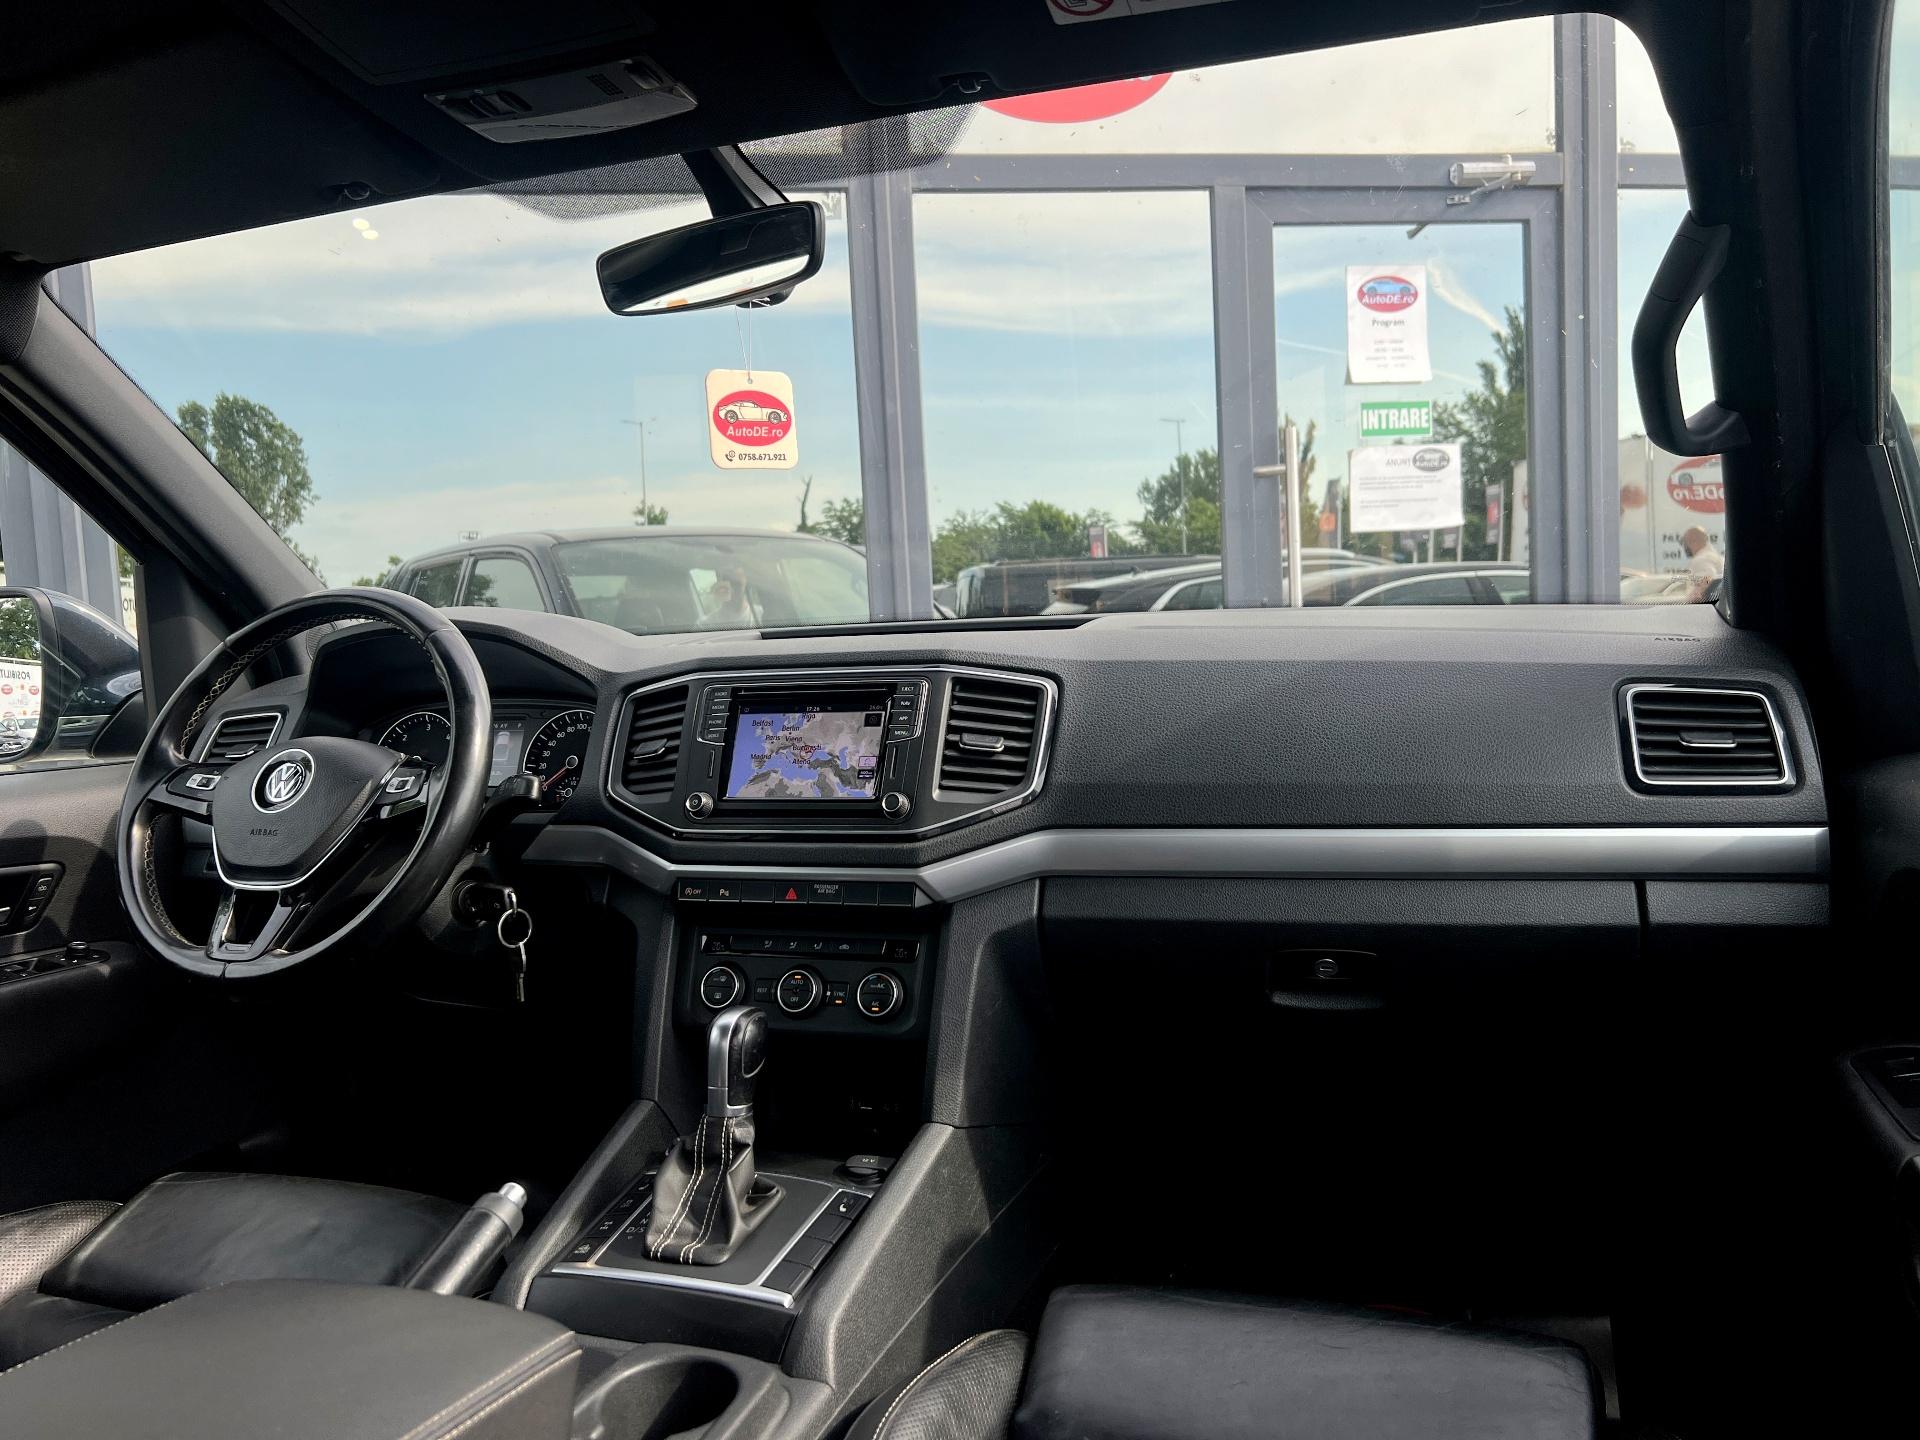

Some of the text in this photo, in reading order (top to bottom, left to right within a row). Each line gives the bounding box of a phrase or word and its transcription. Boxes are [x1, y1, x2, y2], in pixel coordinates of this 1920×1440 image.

[1362, 294, 1415, 305] AutoDE.ro
[1371, 317, 1405, 328] Program
[1362, 407, 1430, 430] INTRARE
[726, 426, 784, 437] AutoDE.ro
[738, 453, 787, 461] 0758.671.921
[250, 829, 278, 837] AIRBAG
